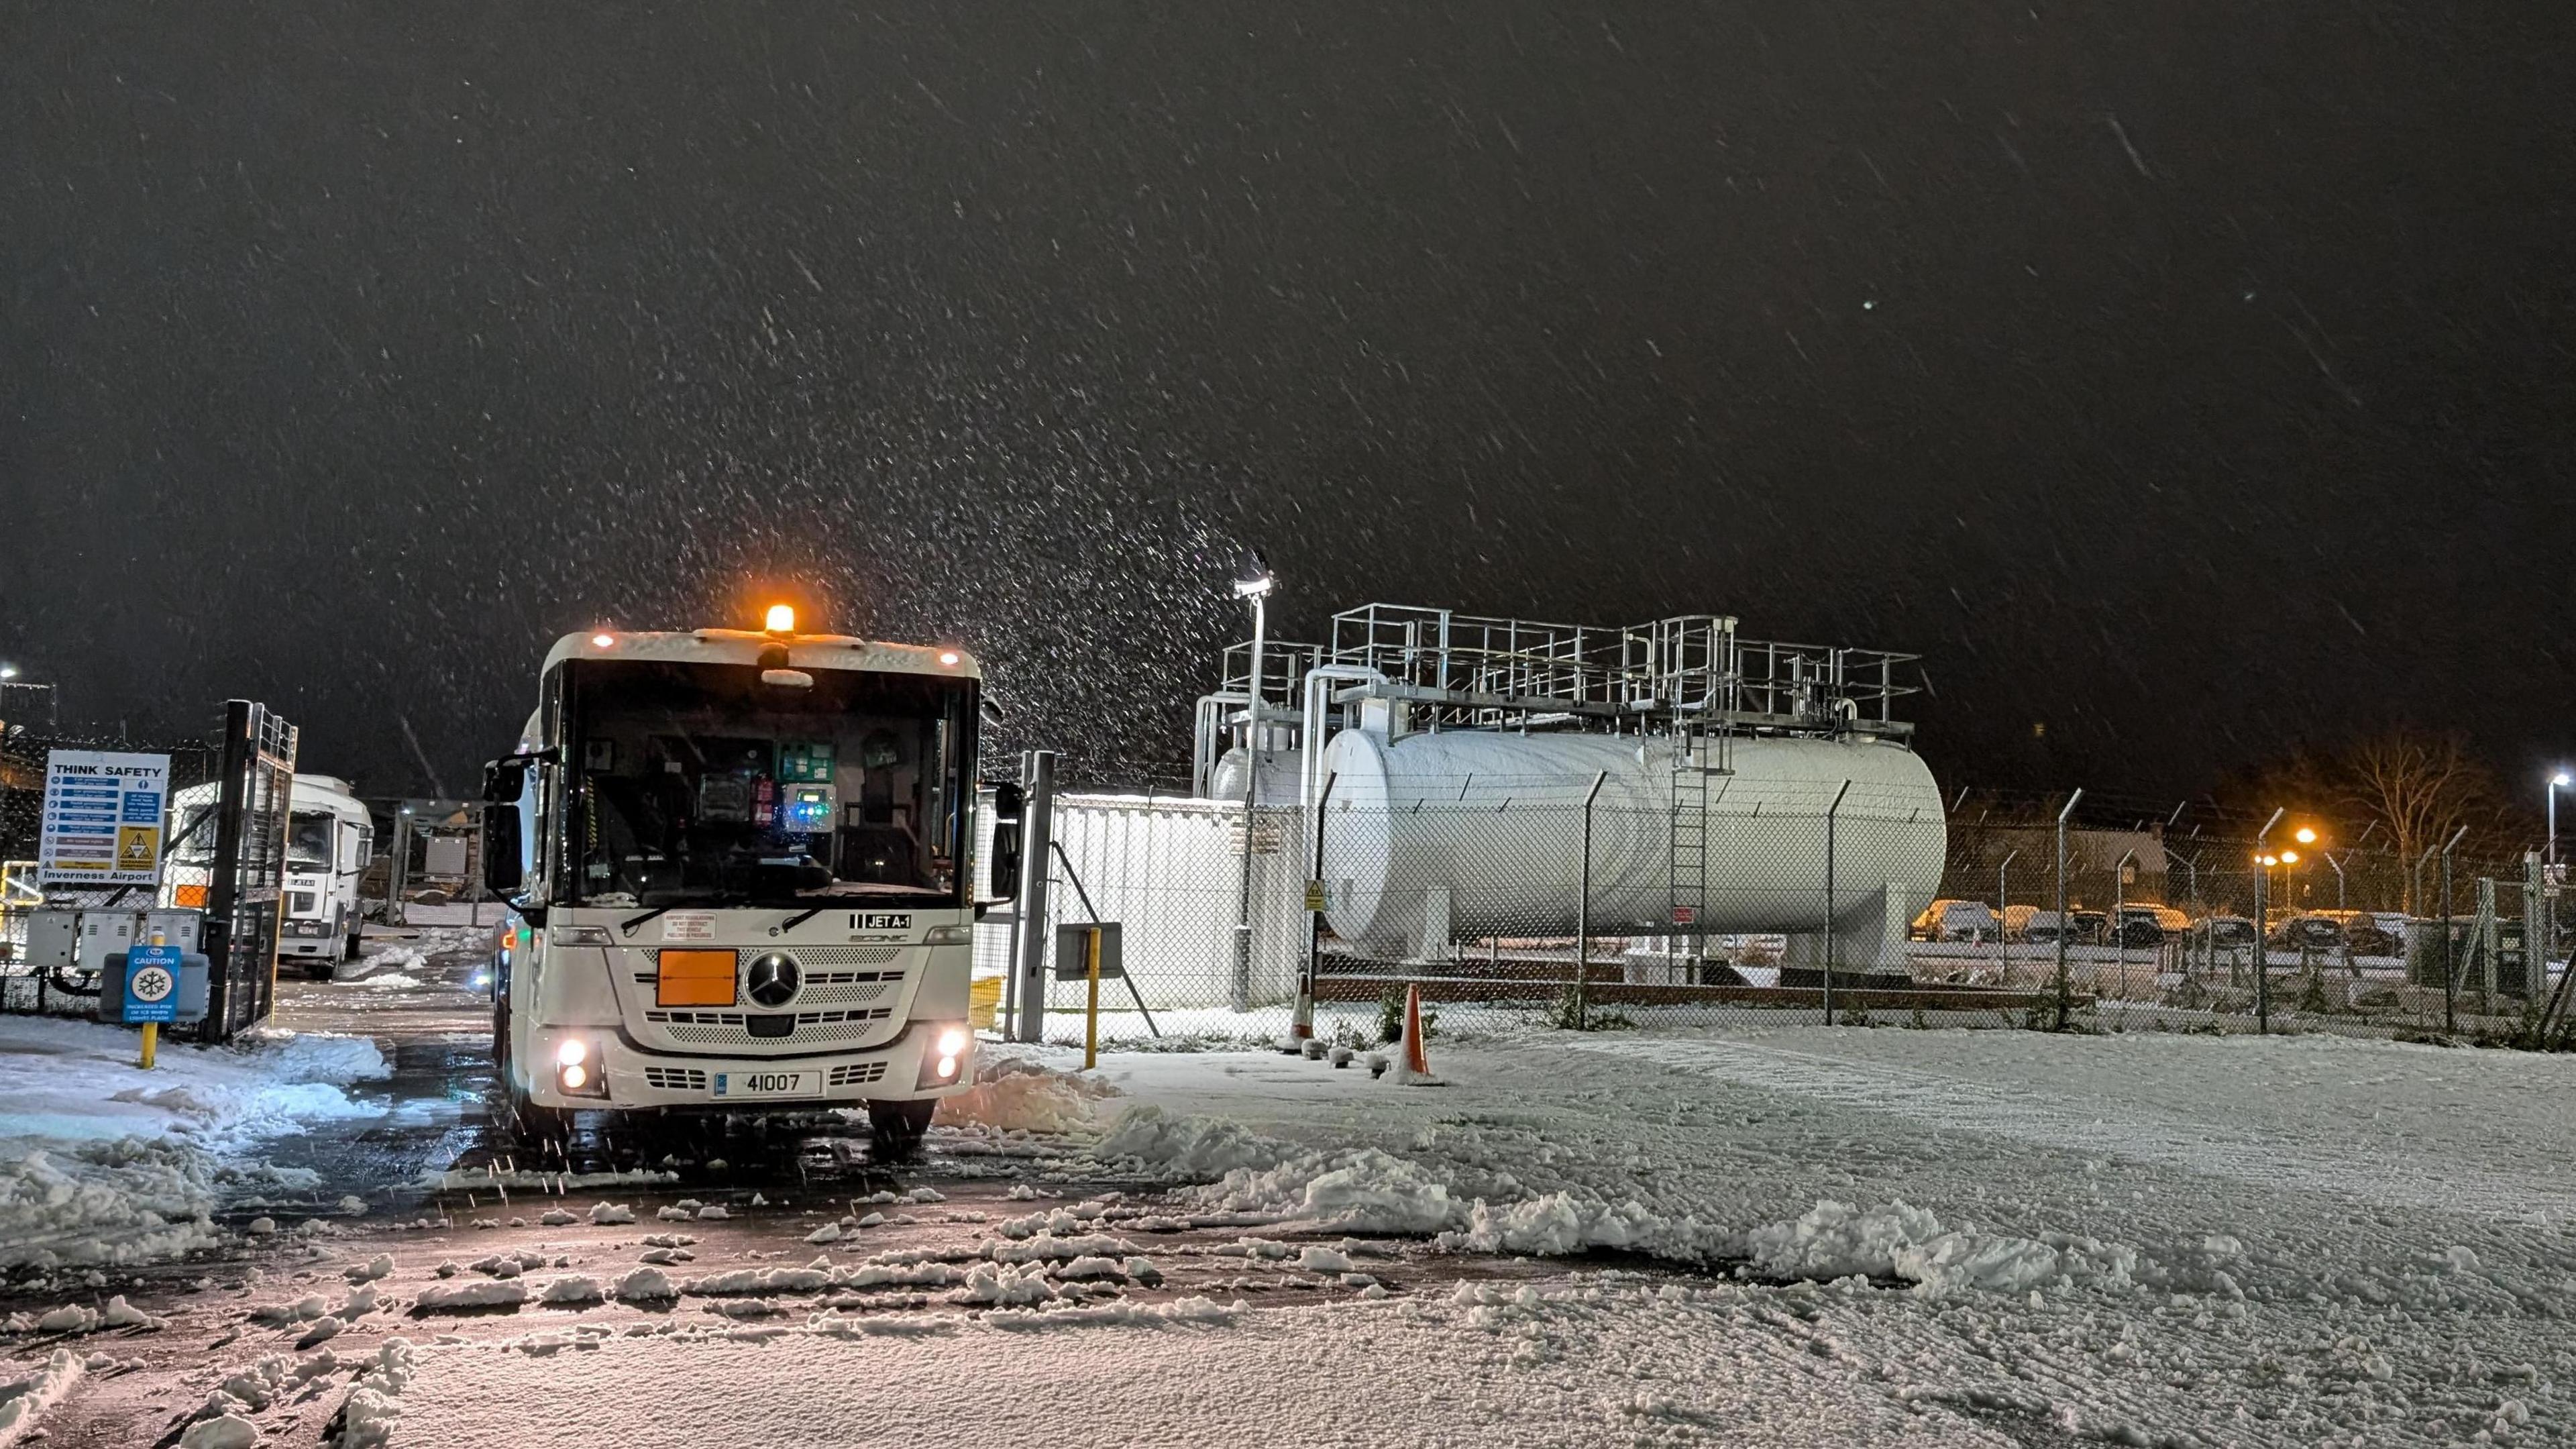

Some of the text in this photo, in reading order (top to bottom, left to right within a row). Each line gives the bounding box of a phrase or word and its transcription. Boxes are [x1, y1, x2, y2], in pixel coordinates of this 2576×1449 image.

[55, 765, 162, 777] THINK SAFETY
[44, 871, 153, 881] Inverness Airport
[869, 916, 910, 927] JET A-1
[747, 1075, 800, 1091] 41007
